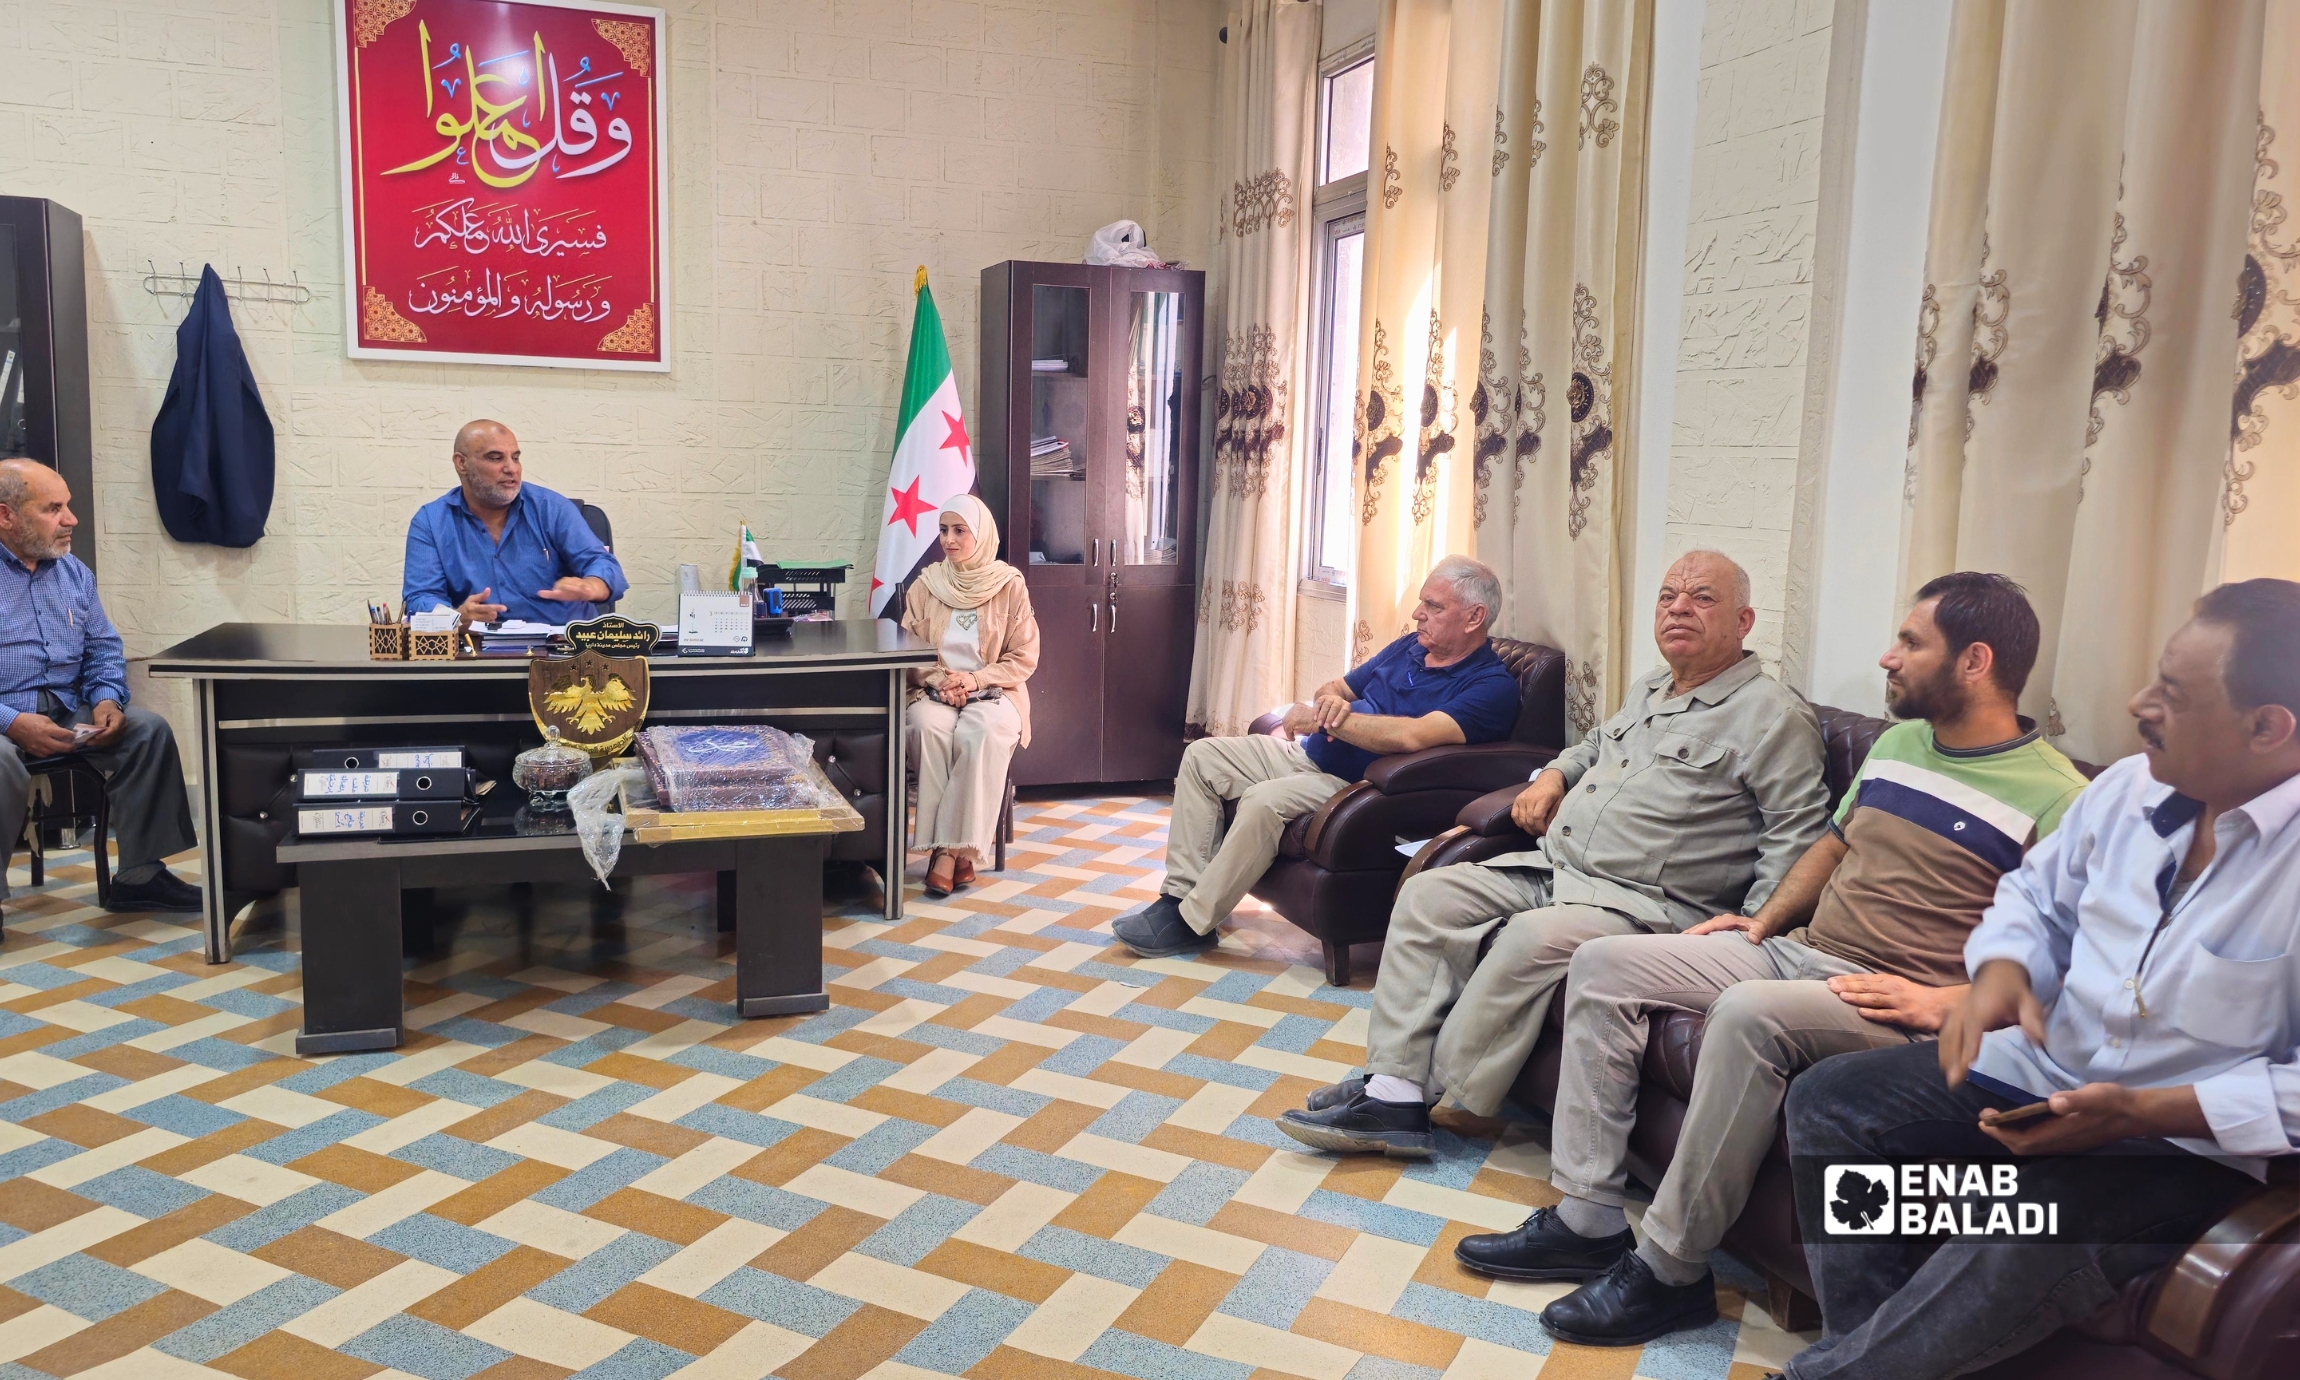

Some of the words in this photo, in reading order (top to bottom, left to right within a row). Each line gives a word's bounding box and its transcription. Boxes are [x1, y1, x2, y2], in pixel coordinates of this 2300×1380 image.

[575, 630, 596, 642] عبيد
[596, 629, 632, 643] سليمان
[633, 630, 650, 642] رائد
